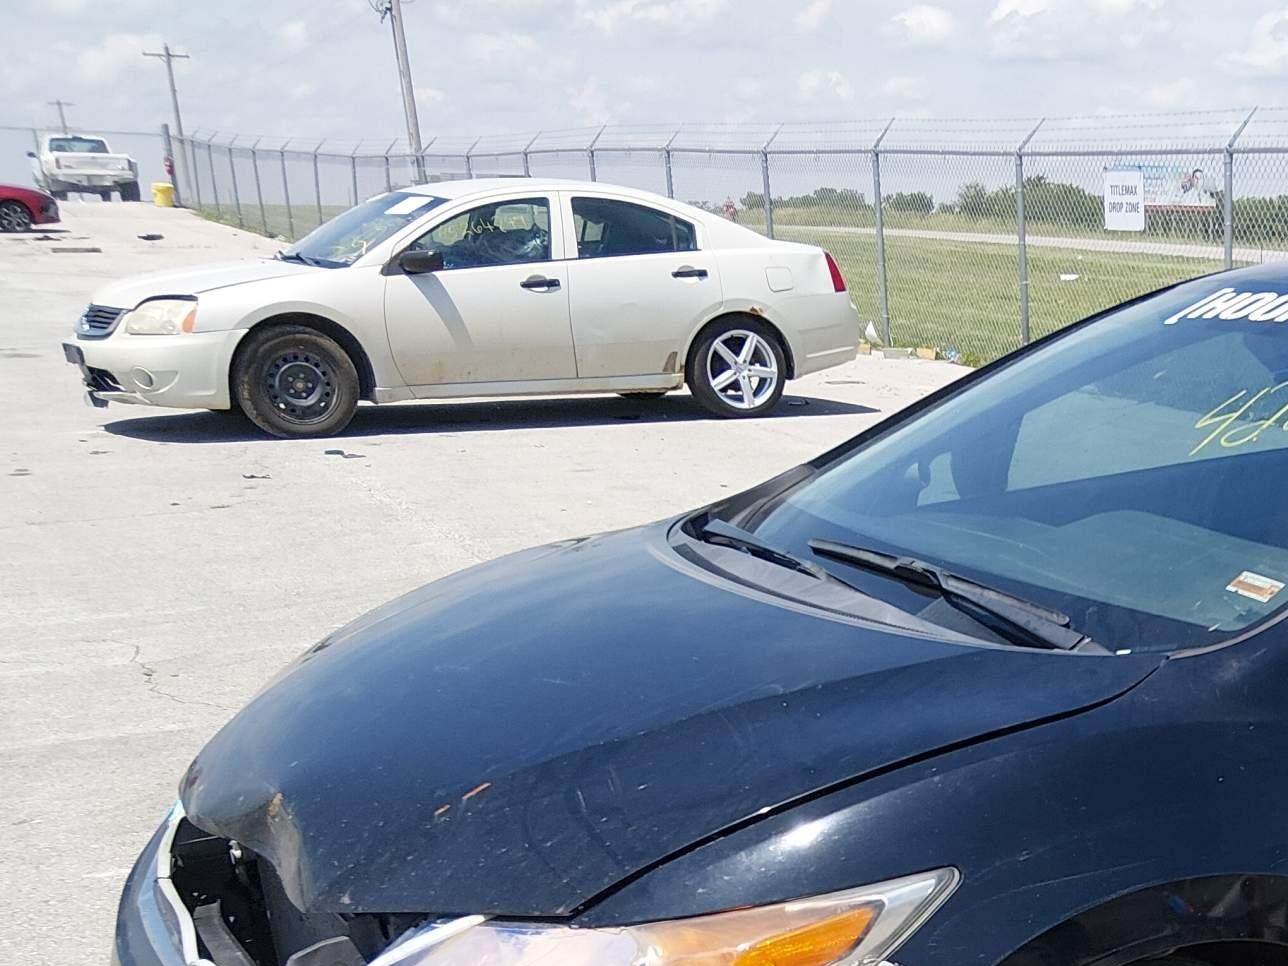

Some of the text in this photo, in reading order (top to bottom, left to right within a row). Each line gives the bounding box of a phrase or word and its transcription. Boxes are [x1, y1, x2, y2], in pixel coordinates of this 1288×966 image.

[1110, 184, 1138, 196] TITLEMAX
[1109, 201, 1140, 214] DROP ZONE
